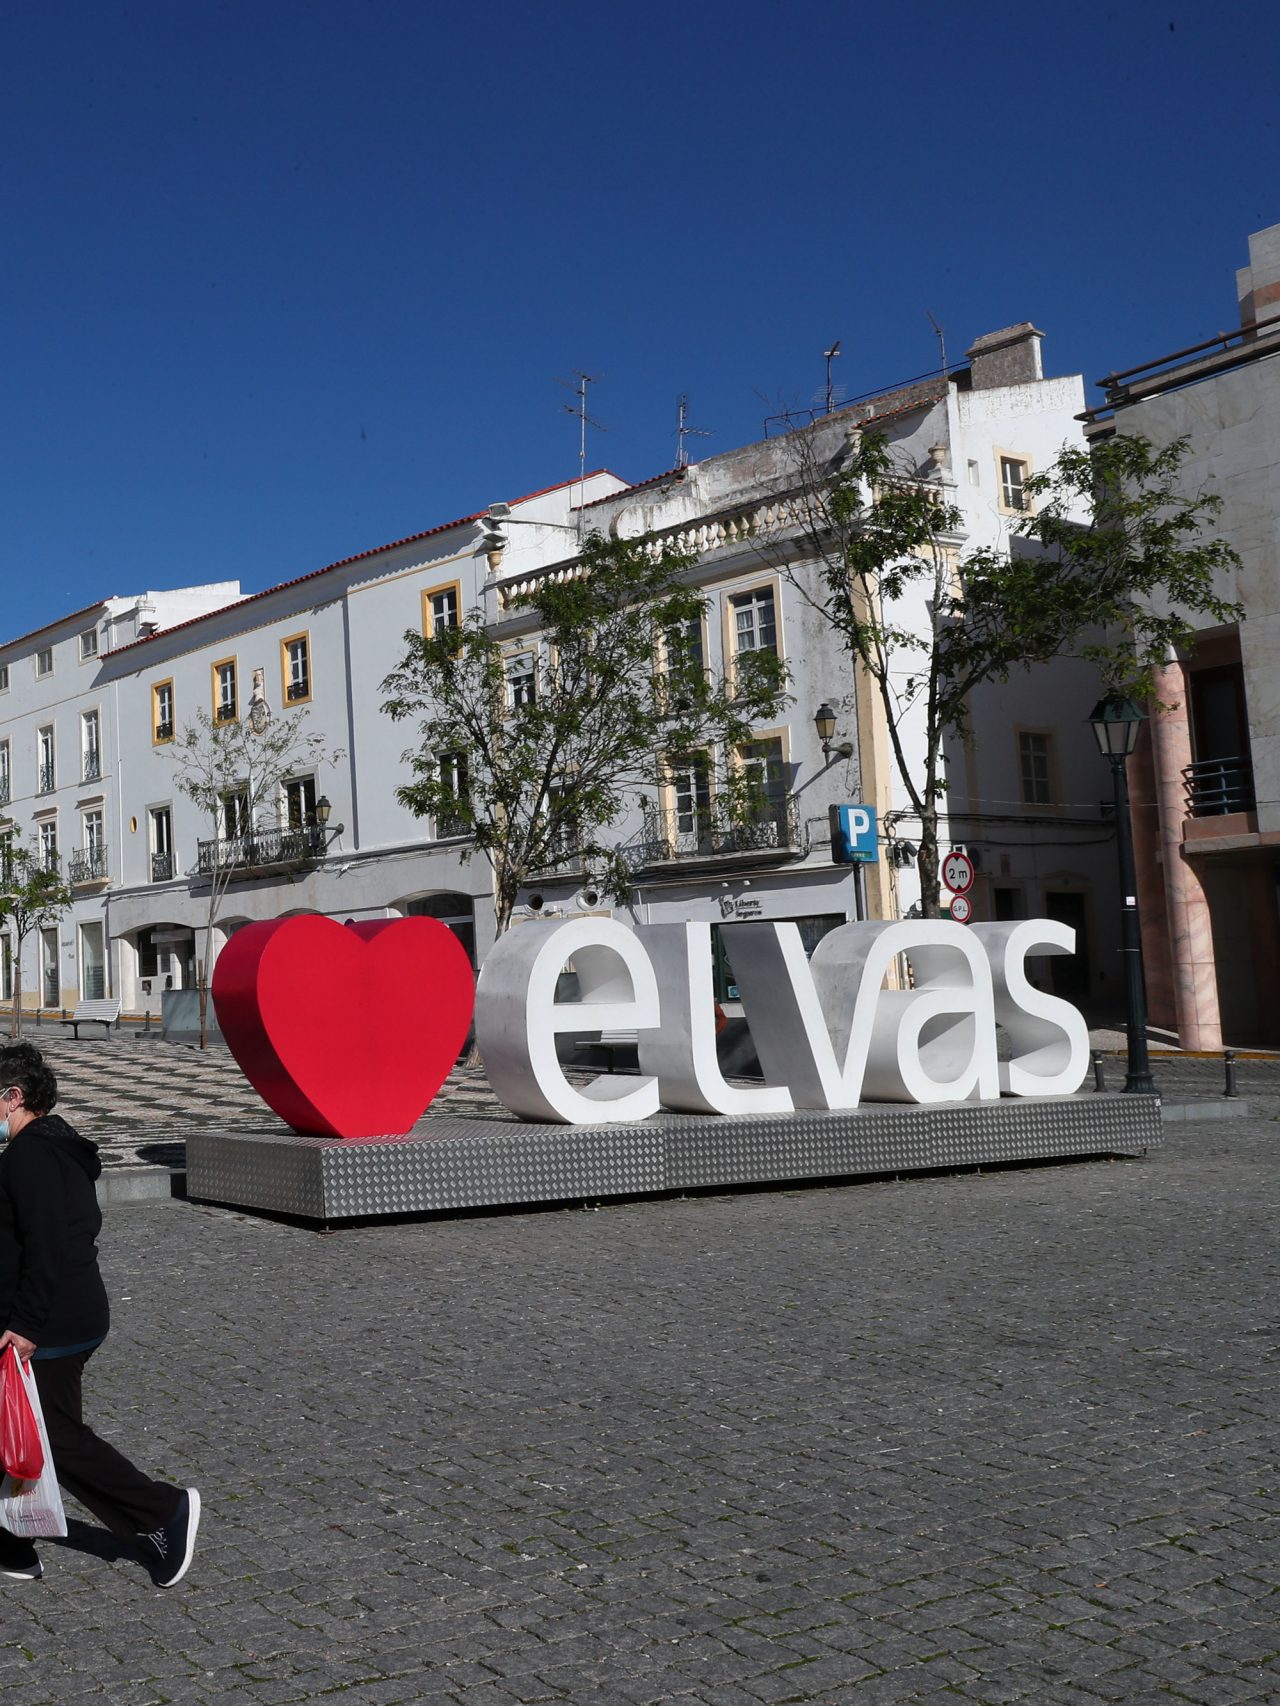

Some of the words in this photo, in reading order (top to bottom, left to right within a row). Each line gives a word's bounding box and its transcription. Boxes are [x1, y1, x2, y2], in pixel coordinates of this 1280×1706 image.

[847, 809, 870, 847] P
[949, 868, 955, 879] 2
[958, 870, 968, 879] m
[526, 917, 1090, 1125] elvas
